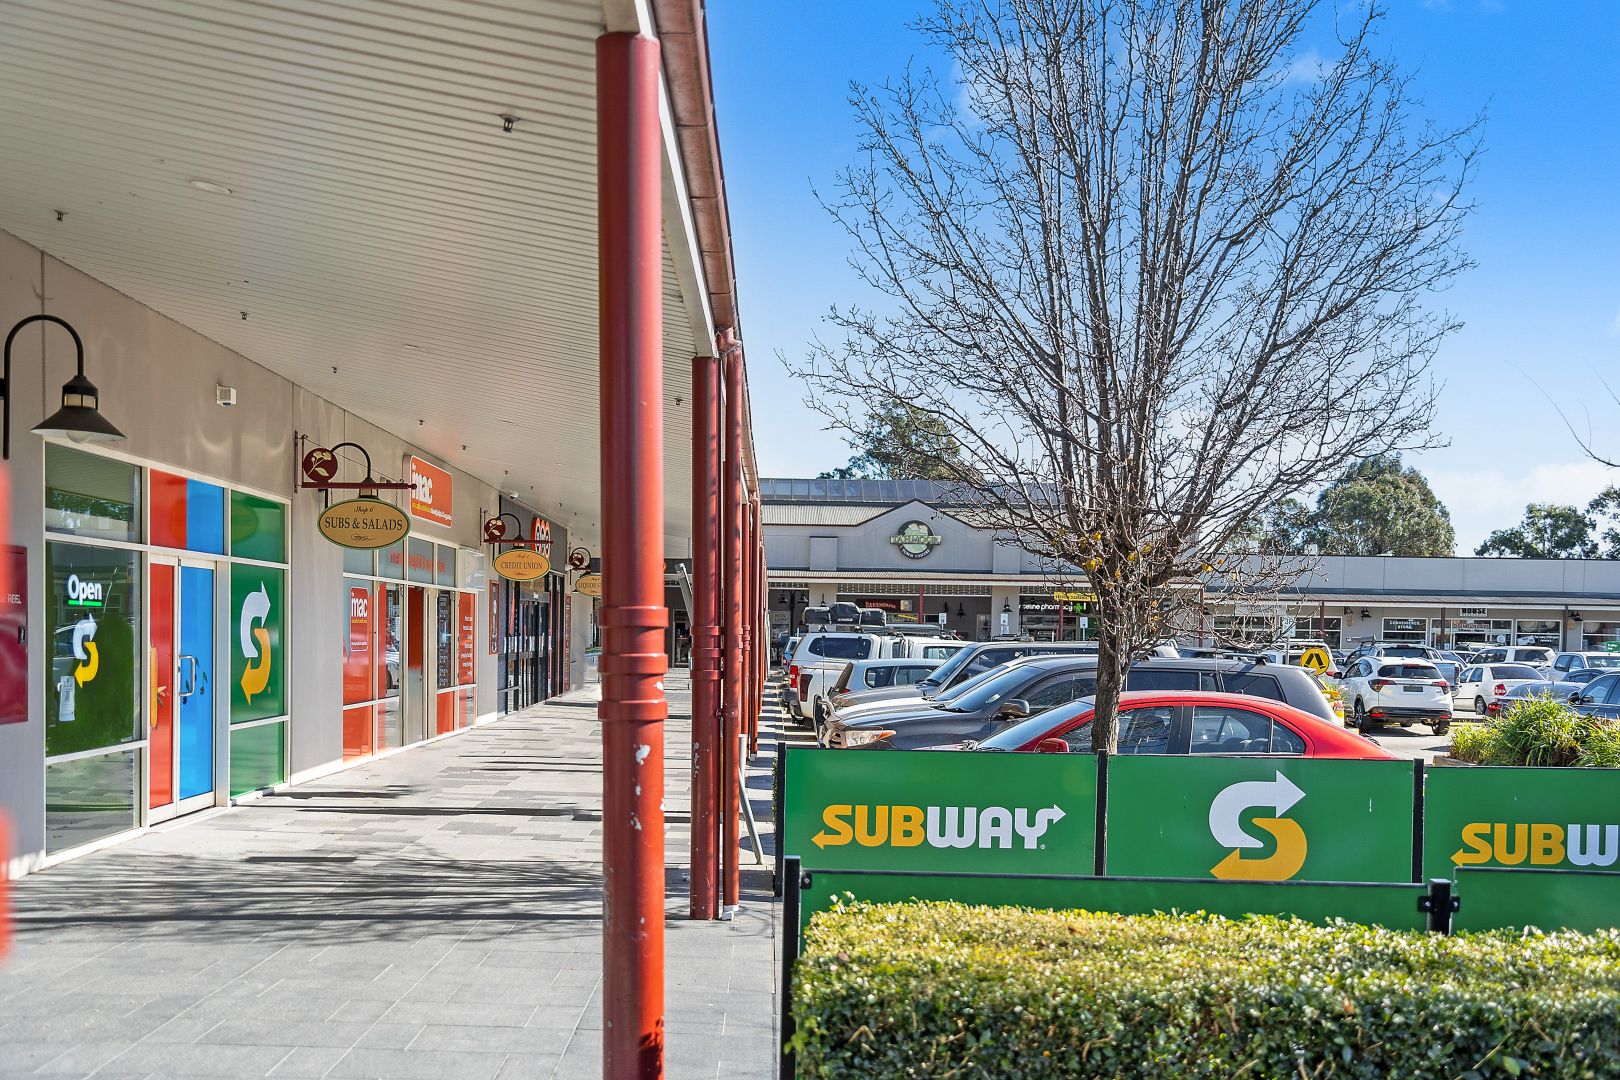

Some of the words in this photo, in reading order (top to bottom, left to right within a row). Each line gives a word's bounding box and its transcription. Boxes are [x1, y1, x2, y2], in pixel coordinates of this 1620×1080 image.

[325, 516, 350, 529] SUBS
[352, 518, 360, 529] &
[362, 518, 403, 530] SALADS
[501, 562, 522, 570] CREDIT
[523, 562, 542, 570] UNION
[67, 574, 102, 605] Open
[352, 597, 368, 617] mac
[811, 803, 1066, 850] SUBWAY
